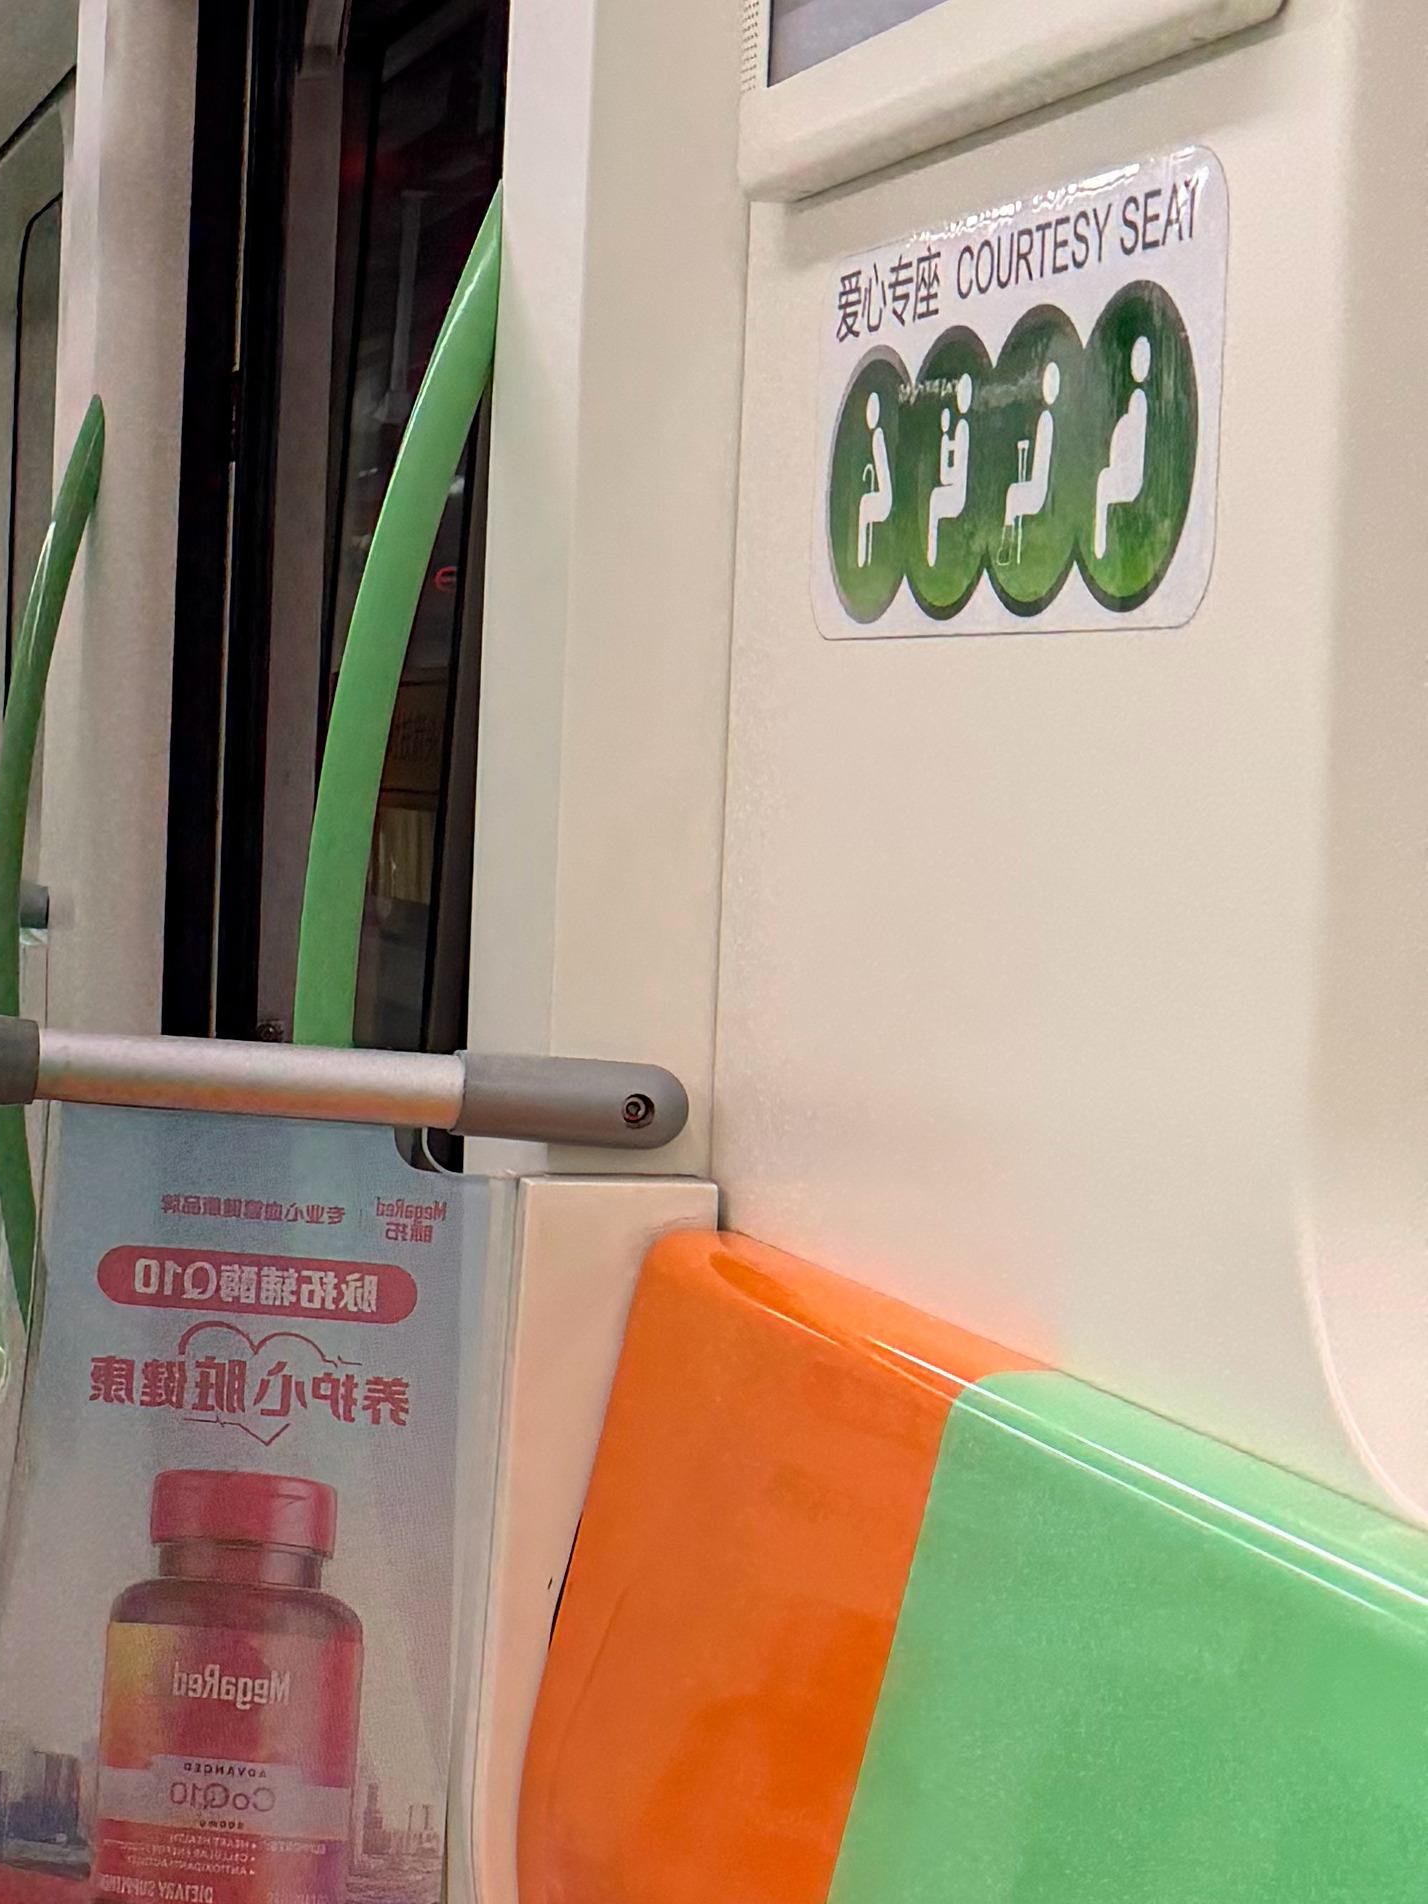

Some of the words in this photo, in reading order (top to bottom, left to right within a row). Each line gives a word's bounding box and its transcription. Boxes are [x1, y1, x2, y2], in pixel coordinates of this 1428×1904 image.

[834, 246, 942, 344] 爱心专座
[956, 204, 1112, 300] COURTESY
[1119, 166, 1210, 257] SEAT
